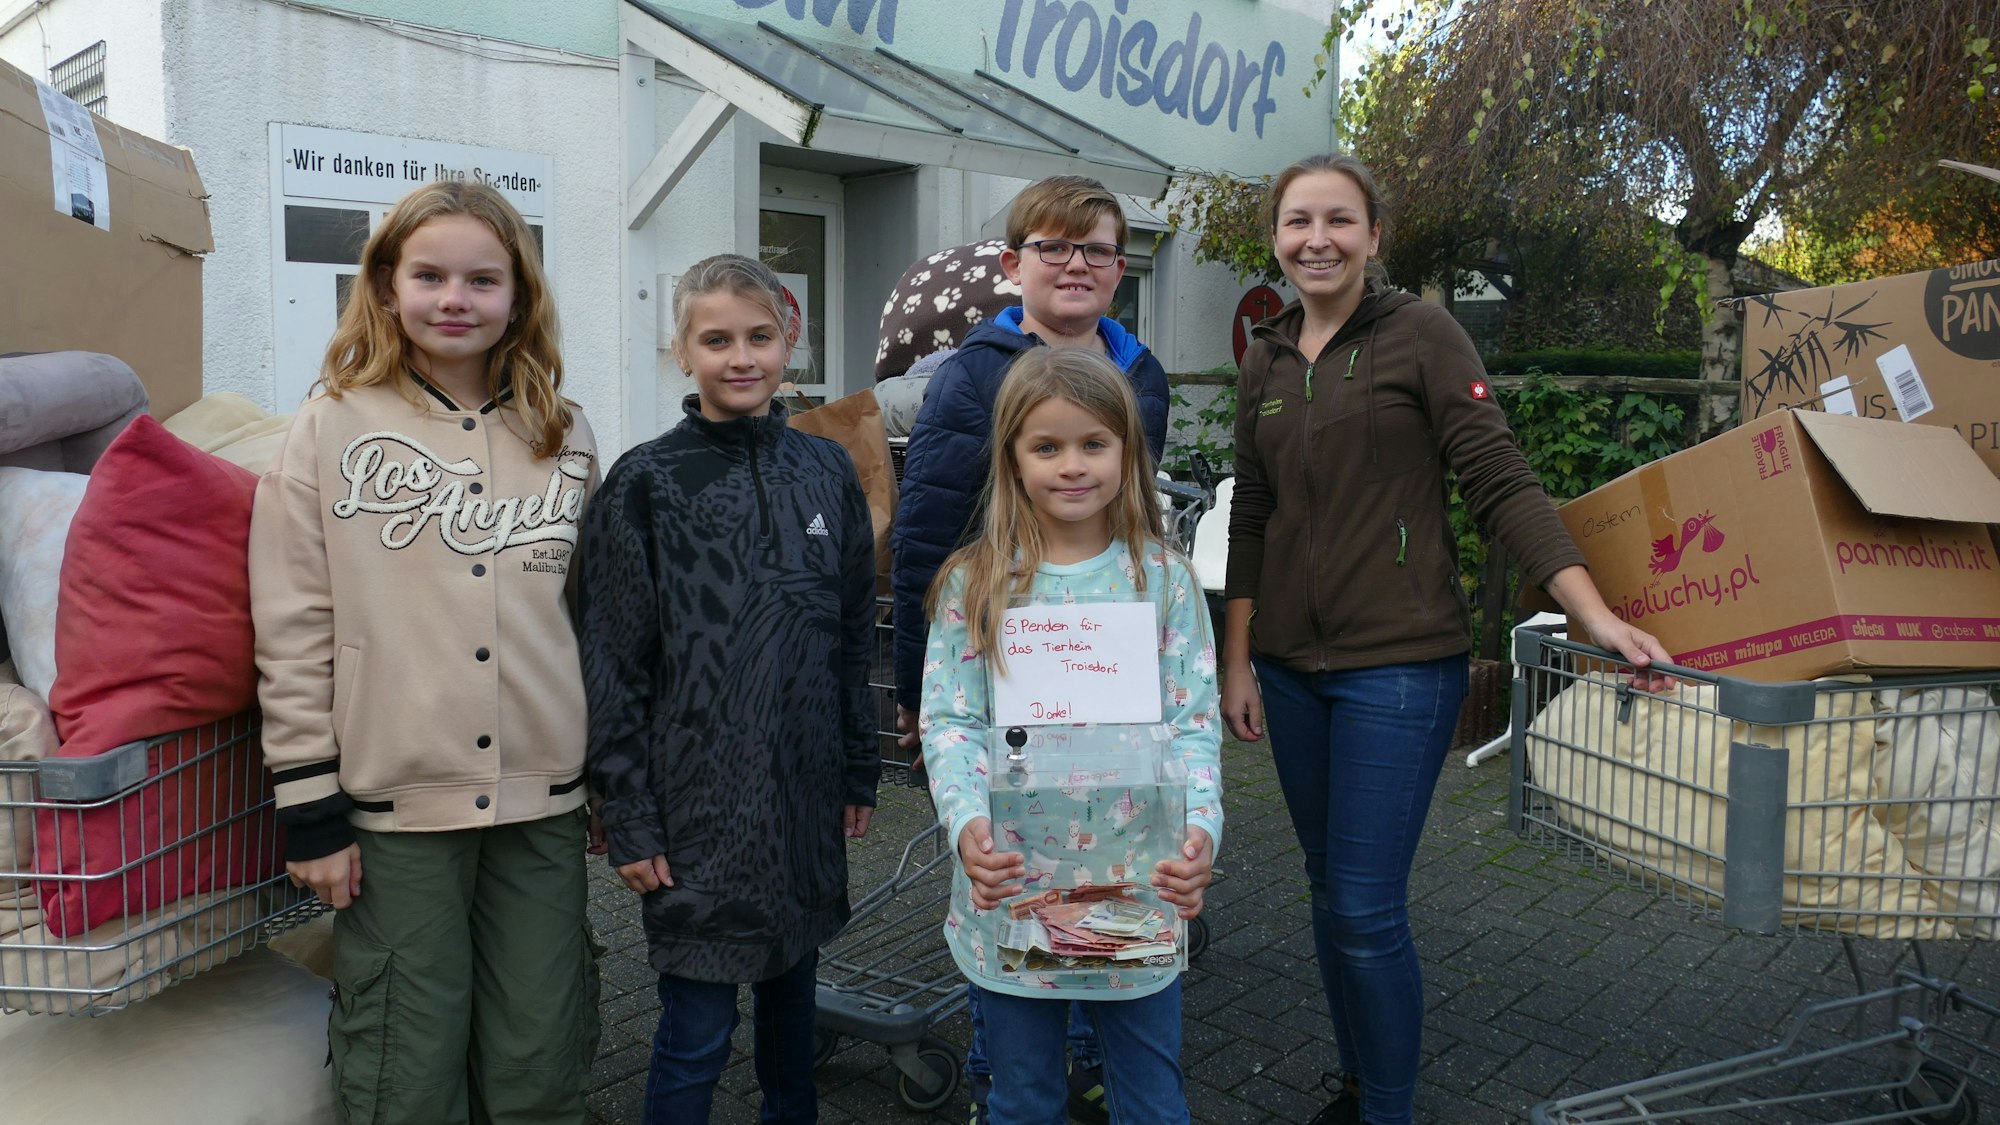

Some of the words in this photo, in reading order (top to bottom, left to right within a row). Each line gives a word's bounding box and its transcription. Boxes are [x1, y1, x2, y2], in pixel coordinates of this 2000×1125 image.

[293, 148, 325, 172] Wir
[333, 153, 395, 179] danken
[403, 160, 427, 182] für
[1752, 435, 1768, 480] FRAGILE
[1774, 425, 1791, 471] FRAGILE
[333, 431, 483, 518] Los
[806, 527, 829, 536] adidas
[1582, 505, 1641, 538] Ostern
[1836, 536, 1991, 574] pannolini.it
[522, 561, 557, 574] Malibu
[1080, 617, 1103, 632] für
[1852, 618, 1885, 637] chicco
[1896, 622, 1923, 637] NUK
[1944, 624, 1976, 639] cybex
[1007, 641, 1033, 655] das
[1042, 638, 1093, 652] Tierheim
[1735, 638, 1783, 657] milupa
[1789, 627, 1837, 648] WELEDA
[1060, 659, 1119, 674] Troisdorf
[1030, 701, 1073, 720] Danke!
[1142, 954, 1174, 965] Zeigis
